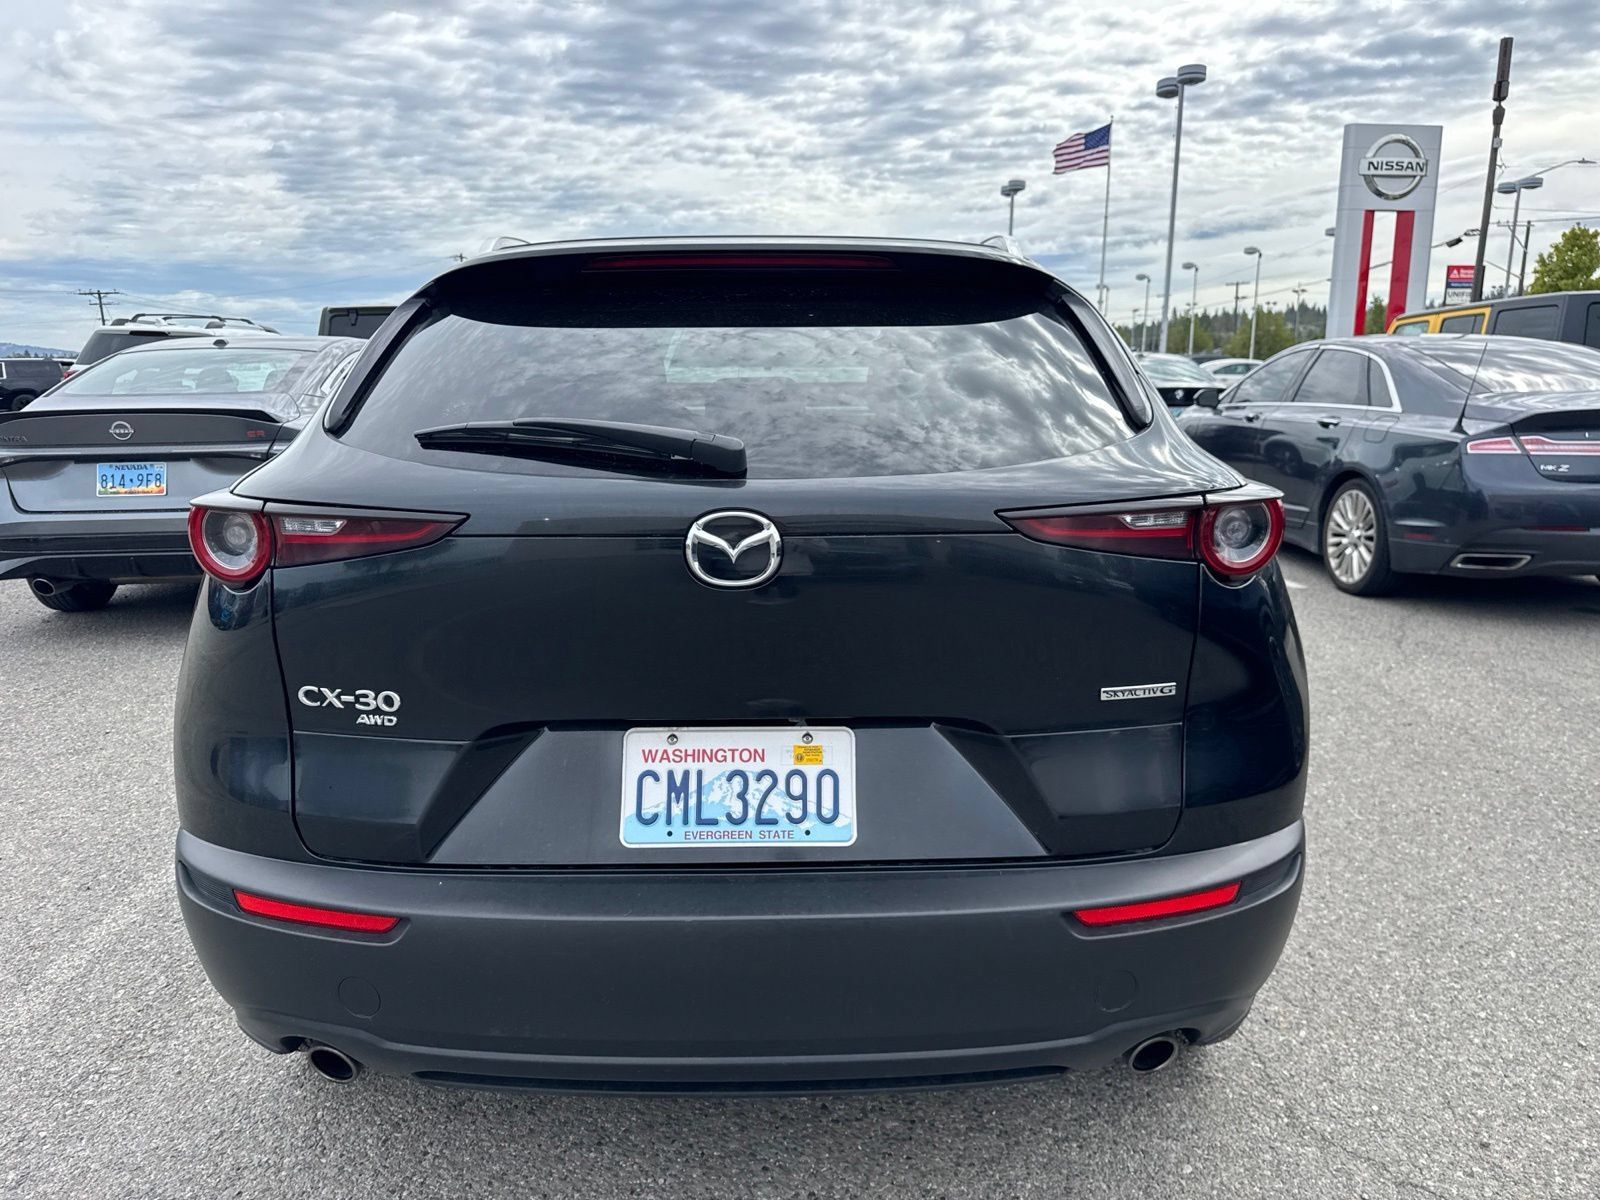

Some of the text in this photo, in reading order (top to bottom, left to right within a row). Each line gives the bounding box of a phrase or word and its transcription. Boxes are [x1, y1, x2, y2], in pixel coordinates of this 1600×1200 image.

[1367, 160, 1425, 172] NISSAN
[297, 685, 401, 713] CX-30
[355, 713, 398, 727] AWD
[641, 748, 766, 764] WASHINGTON
[635, 768, 840, 826] CML3290
[684, 829, 795, 841] EVERGREEN STATE
